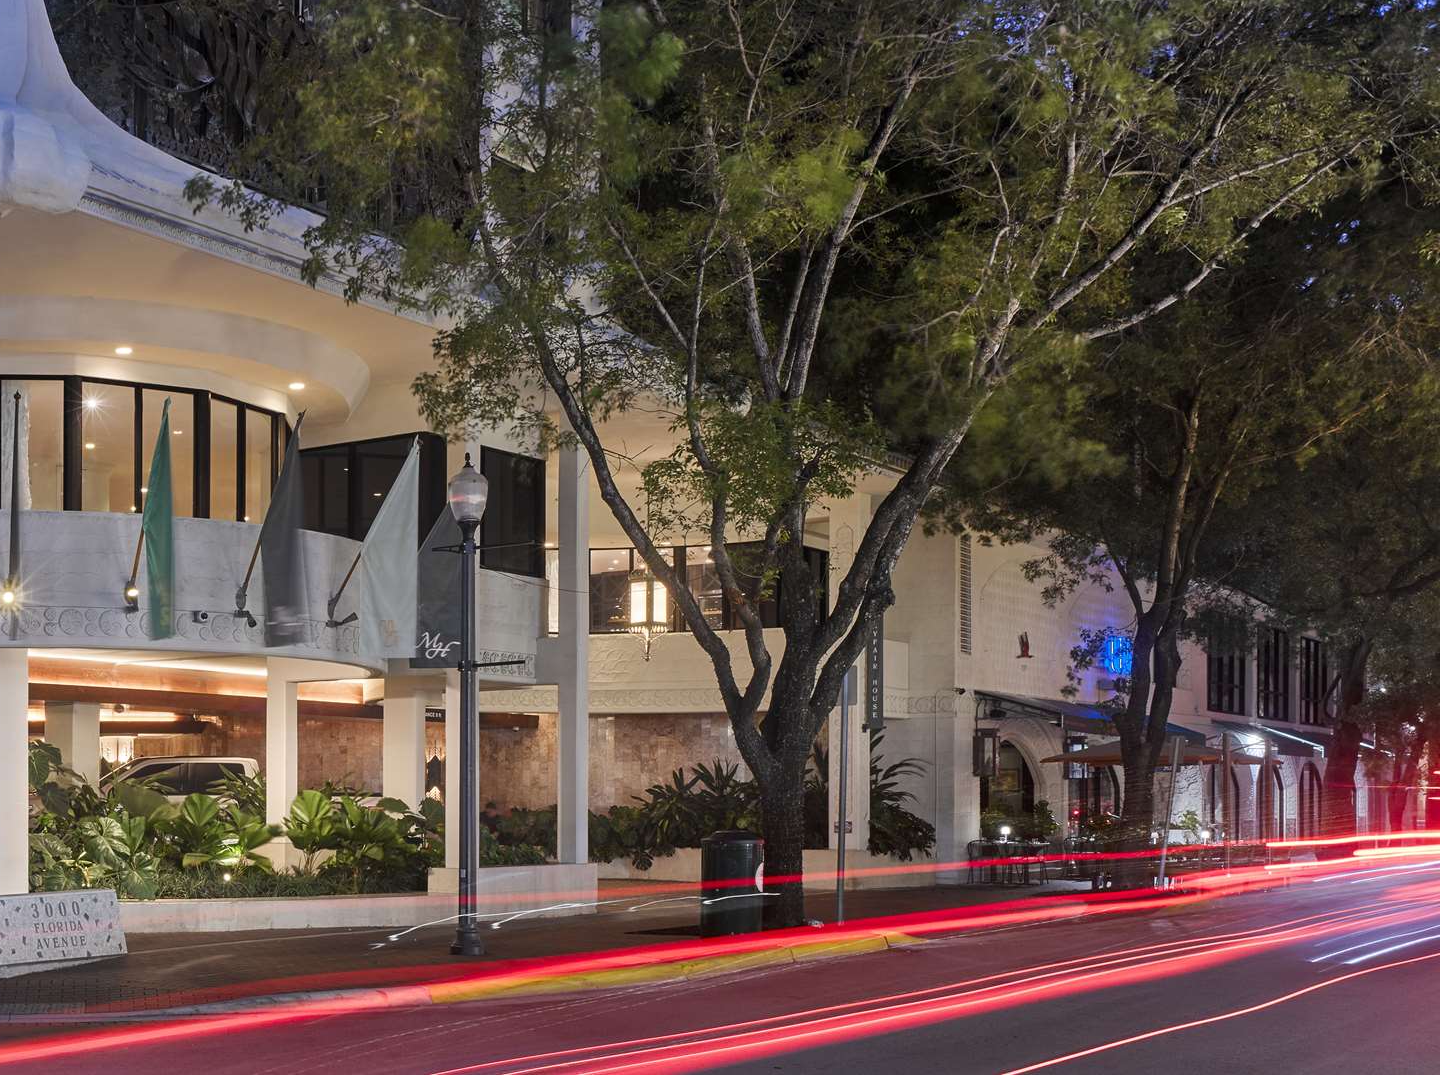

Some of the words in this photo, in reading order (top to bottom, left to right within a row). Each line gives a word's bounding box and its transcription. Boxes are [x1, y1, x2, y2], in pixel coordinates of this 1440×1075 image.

[31, 900, 80, 918] 3000
[33, 920, 84, 933] FLORIDA
[37, 935, 87, 949] AVENUE
